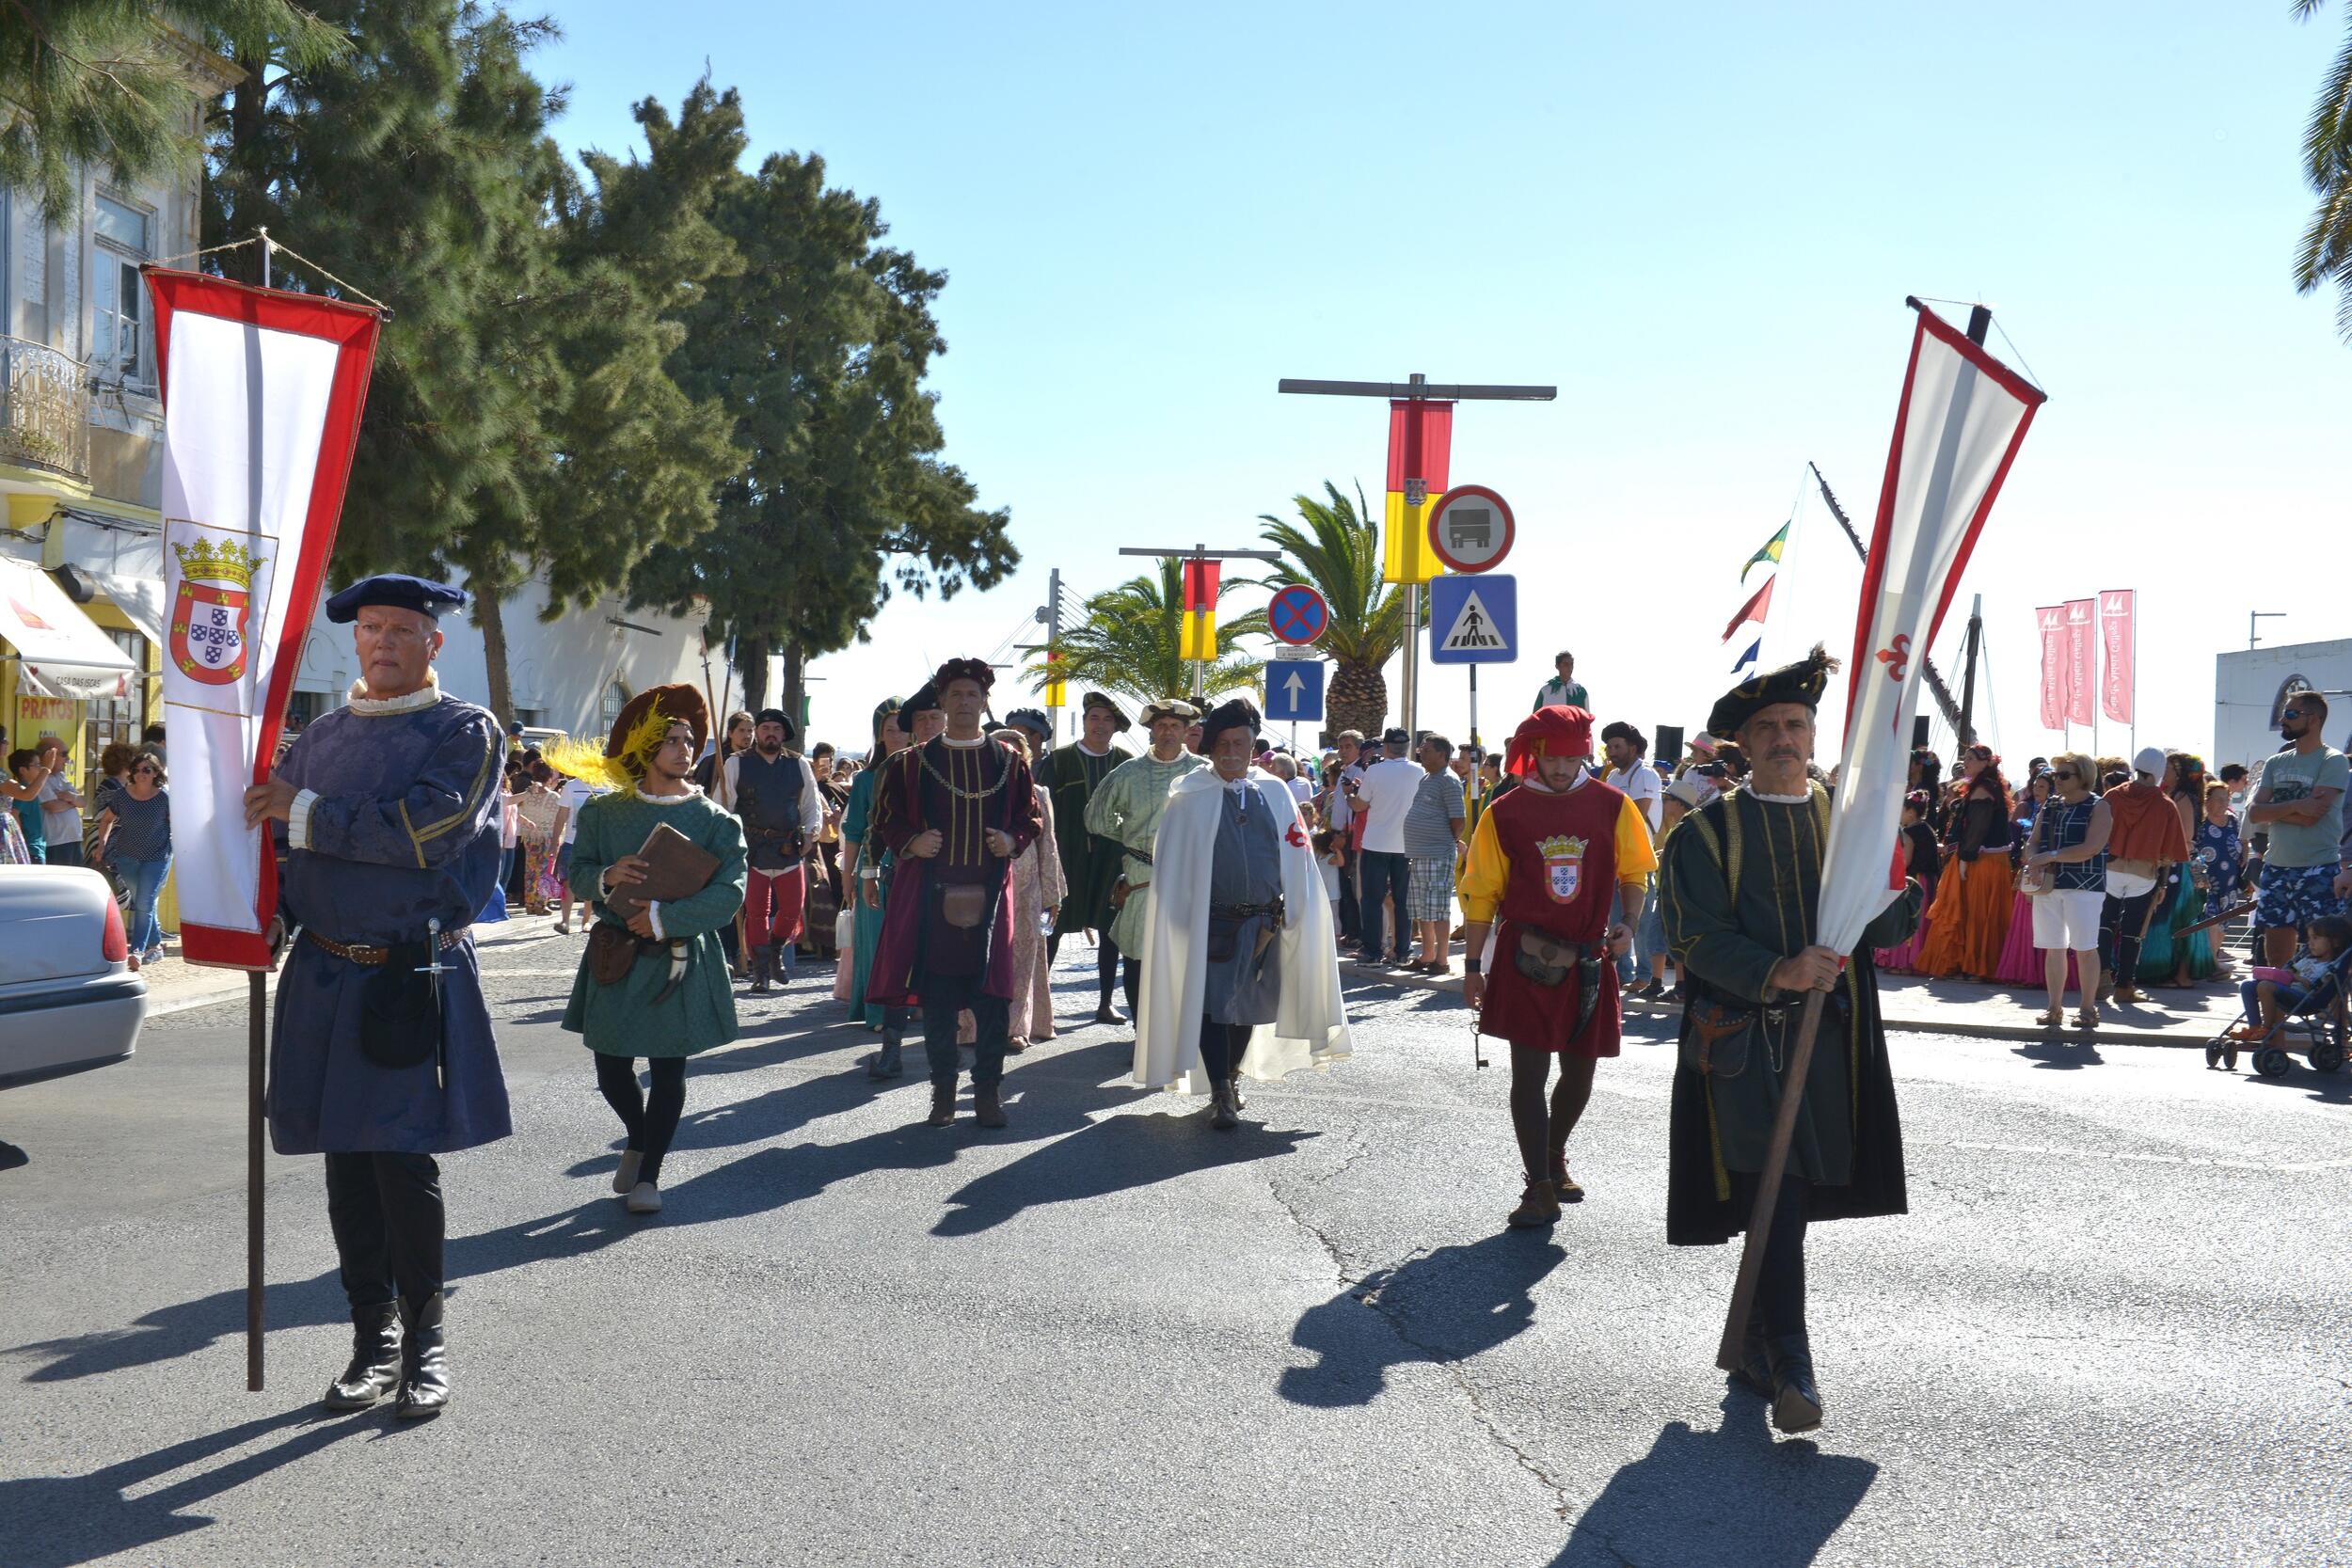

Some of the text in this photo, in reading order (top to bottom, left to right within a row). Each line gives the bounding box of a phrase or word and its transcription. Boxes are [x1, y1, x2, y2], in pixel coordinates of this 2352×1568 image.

[56, 676, 102, 688] CASA DAS ISCAS
[22, 698, 75, 720] PRATOS
